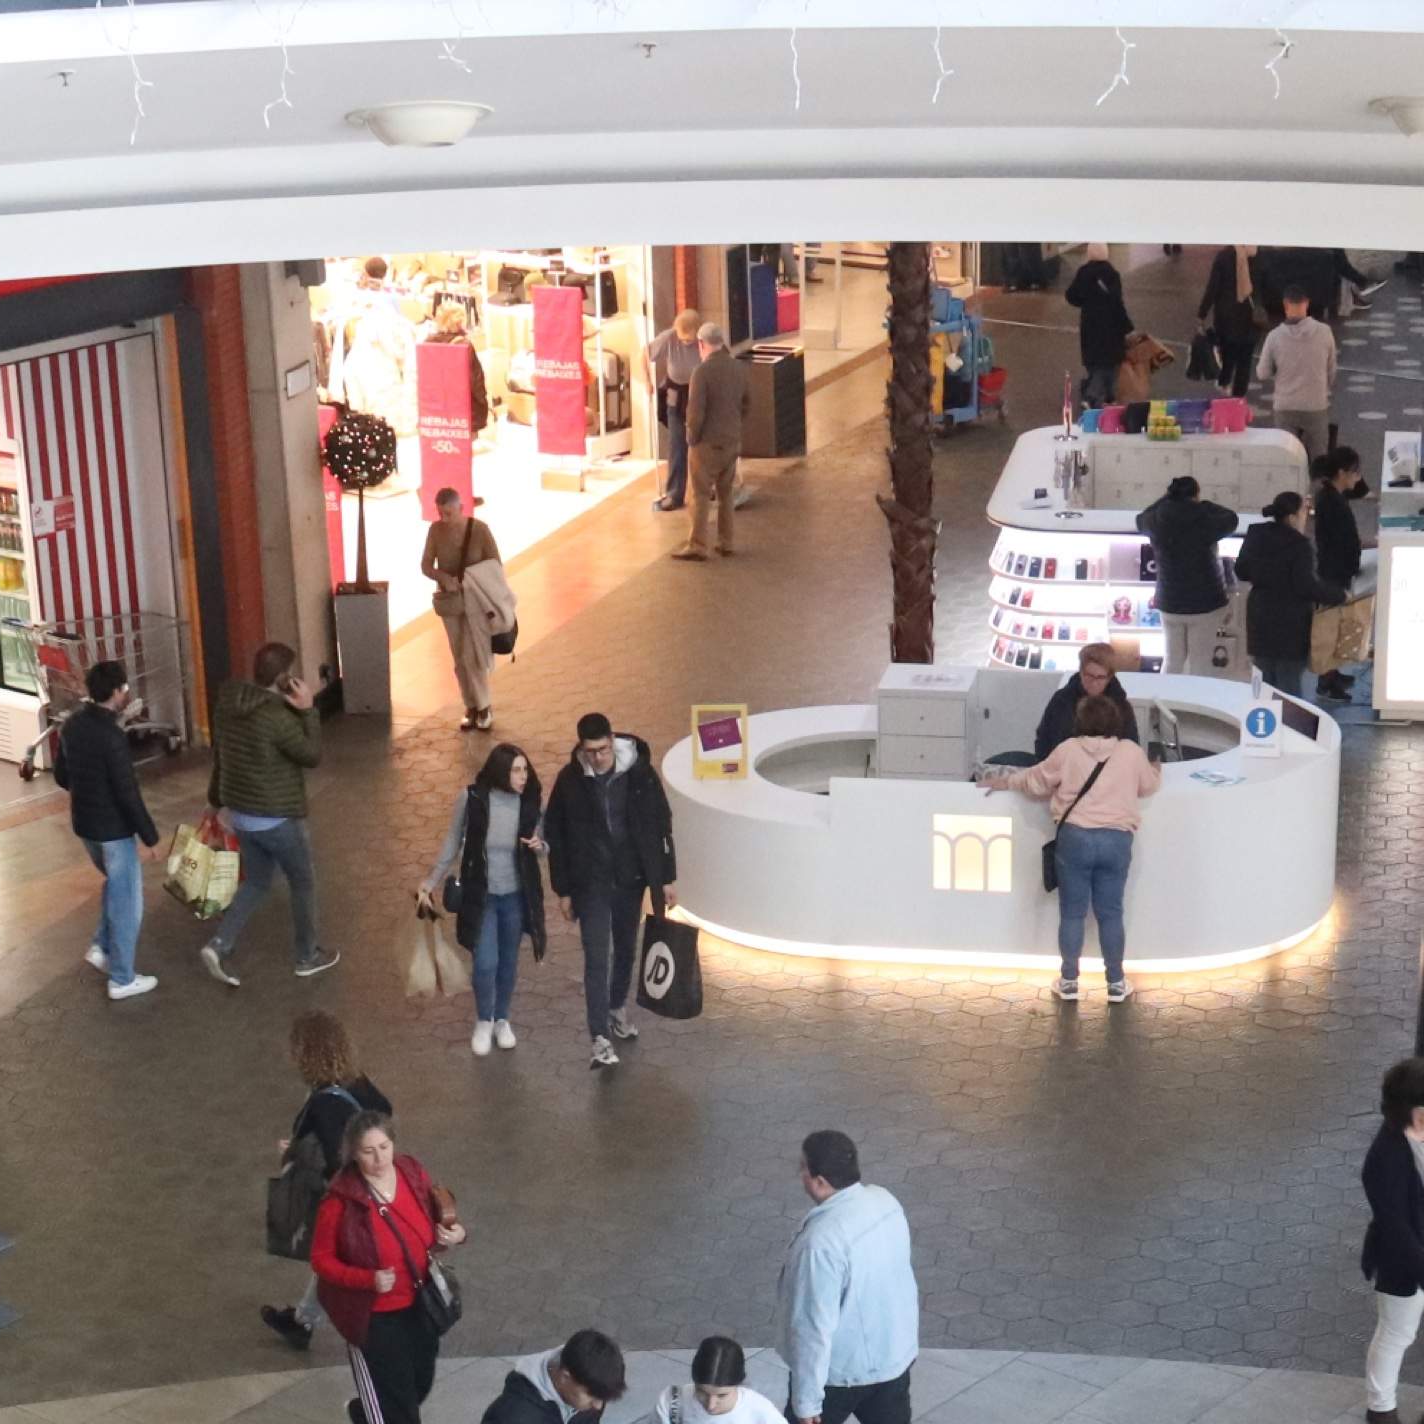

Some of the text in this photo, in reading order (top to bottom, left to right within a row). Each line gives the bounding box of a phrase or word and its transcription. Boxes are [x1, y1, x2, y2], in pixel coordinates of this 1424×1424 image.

[421, 416, 468, 429] REBAJAS
[421, 427, 470, 440] REBAIXES
[645, 954, 670, 985] JD
